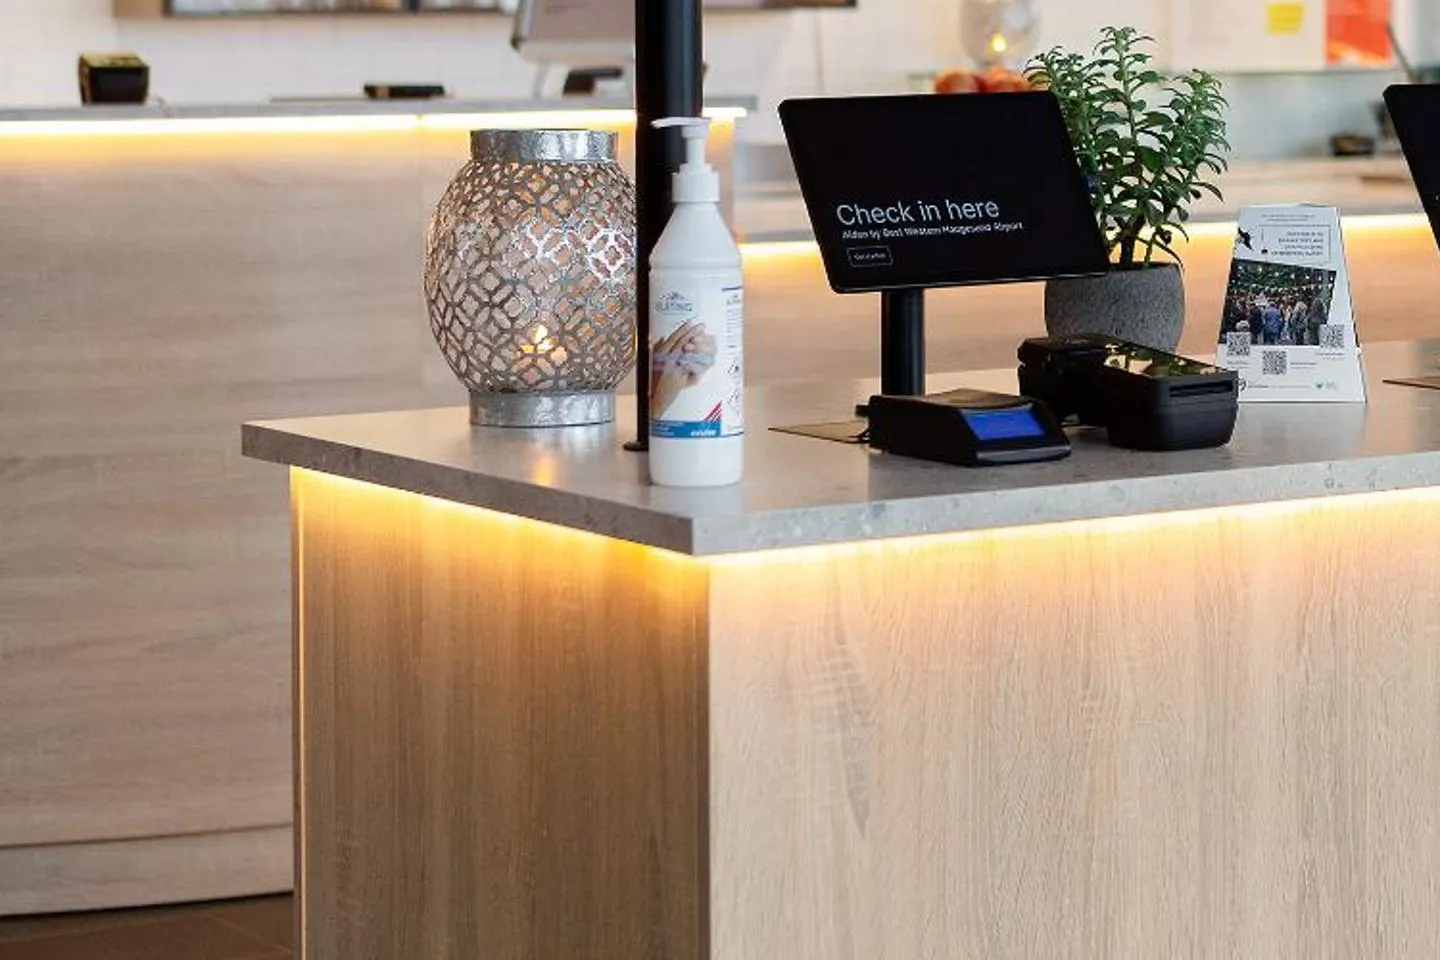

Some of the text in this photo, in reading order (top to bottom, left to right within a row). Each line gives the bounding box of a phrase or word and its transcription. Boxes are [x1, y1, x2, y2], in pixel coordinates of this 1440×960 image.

[836, 198, 1000, 226] Check in here
